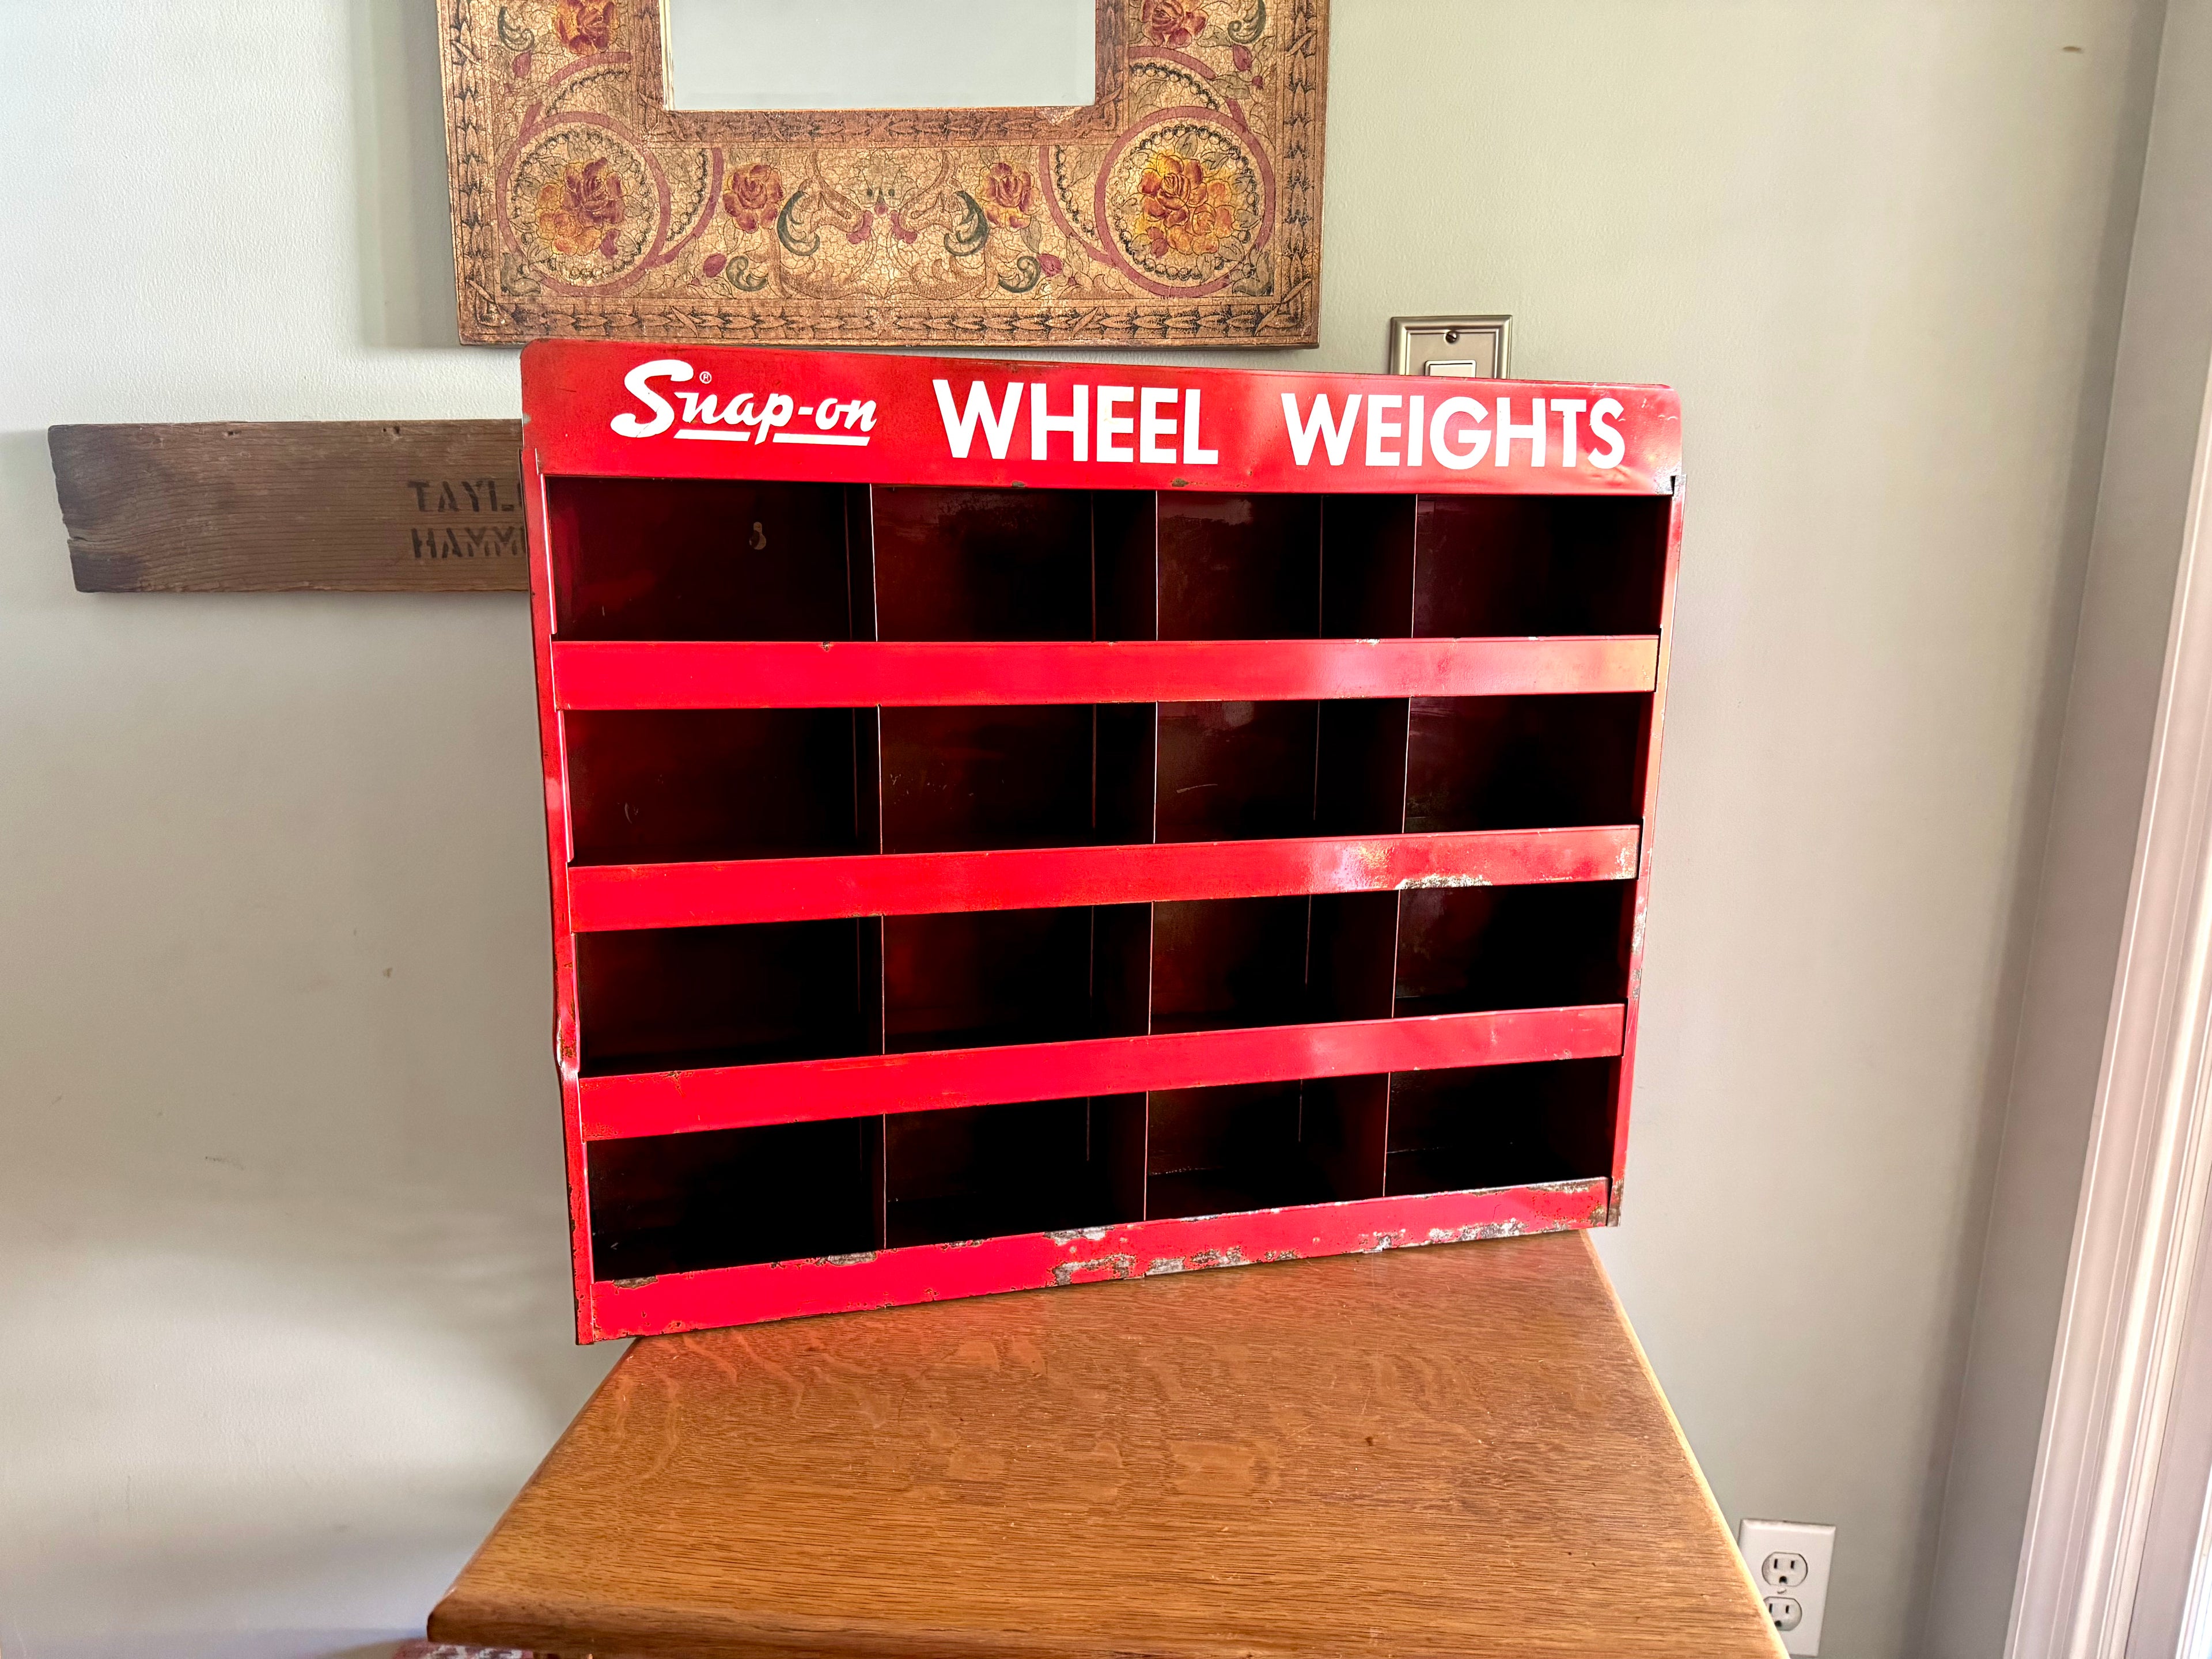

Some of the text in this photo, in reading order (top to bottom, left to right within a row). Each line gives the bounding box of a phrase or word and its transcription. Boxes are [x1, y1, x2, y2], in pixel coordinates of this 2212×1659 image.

[611, 359, 1626, 469] Snap-on WHEEL WEIGHTS
[407, 480, 522, 512] TAYL
[411, 525, 527, 558] HAMM
